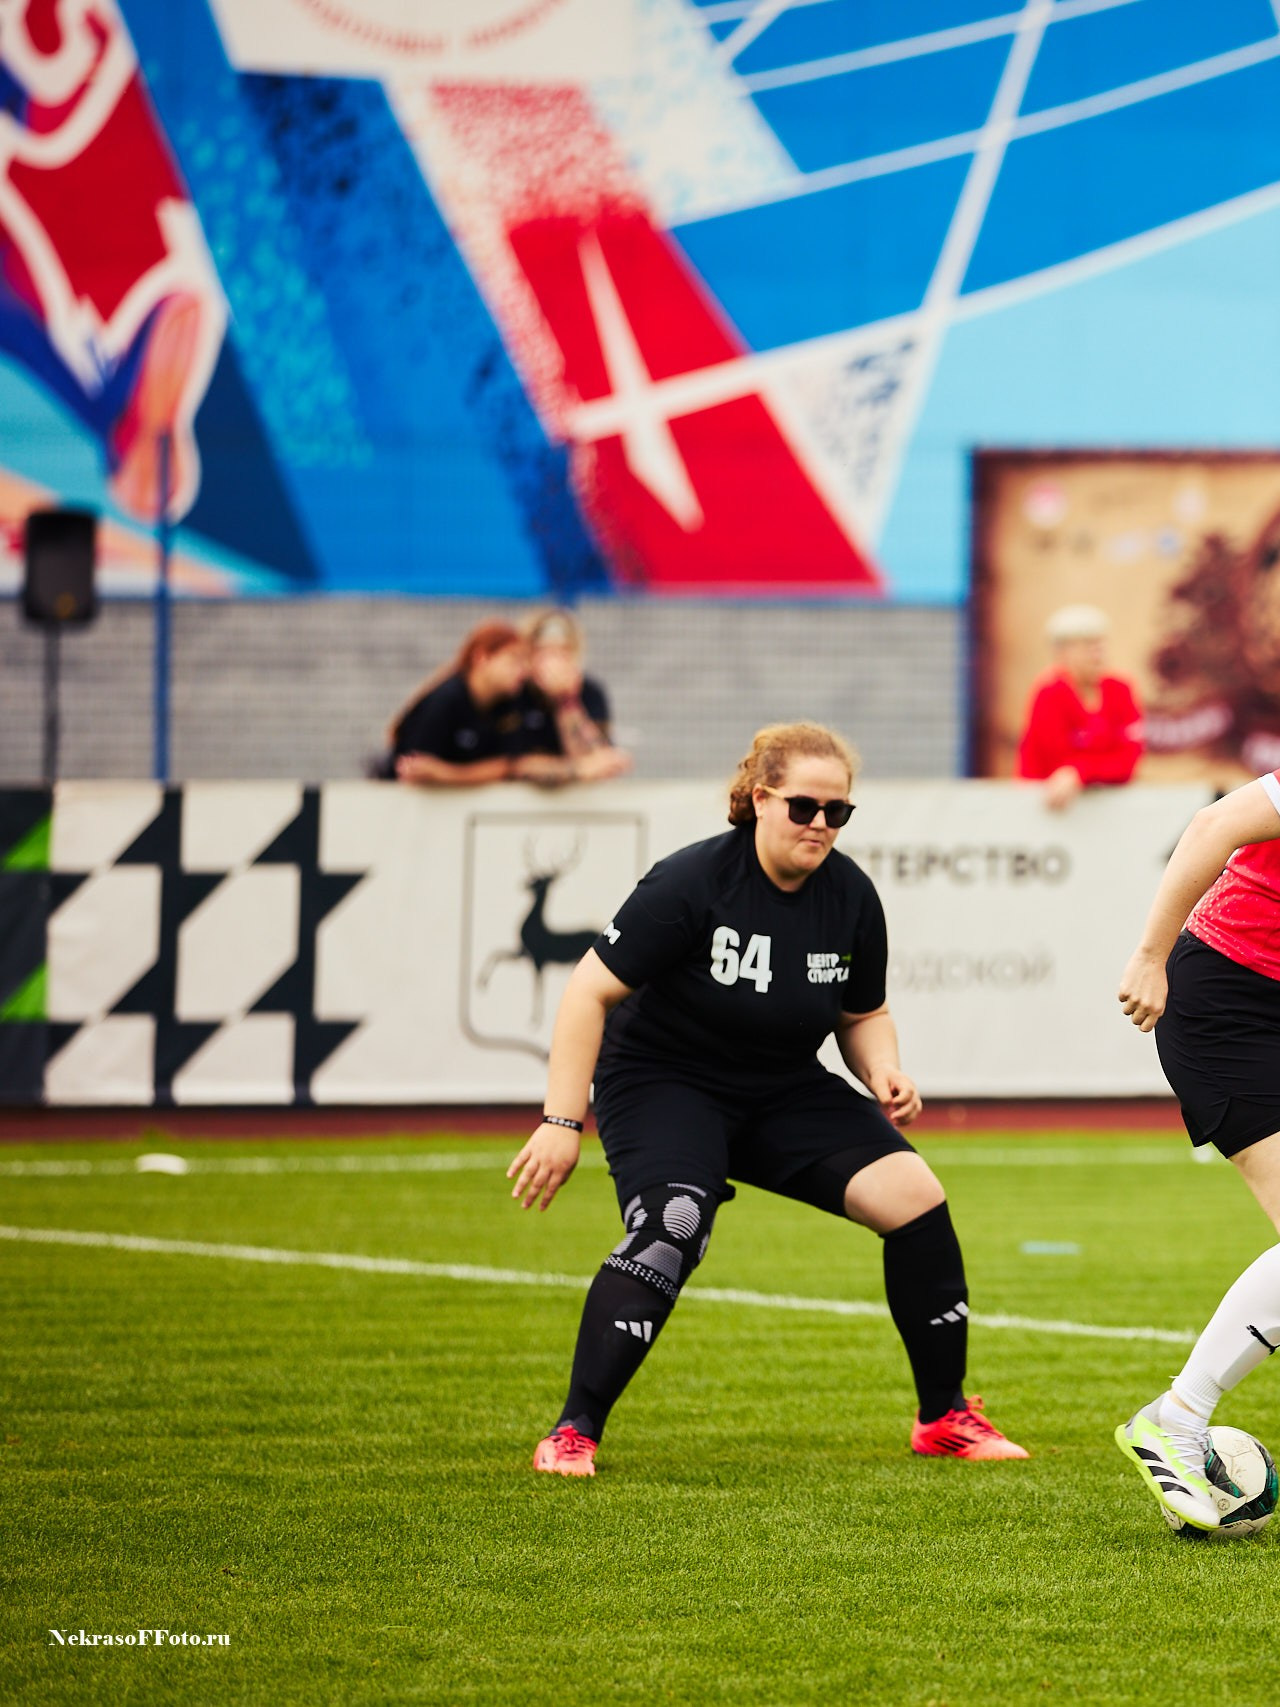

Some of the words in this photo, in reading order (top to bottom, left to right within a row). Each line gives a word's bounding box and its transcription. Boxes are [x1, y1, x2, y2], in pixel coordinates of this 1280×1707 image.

[854, 846, 1070, 883] ТЕРСТВО
[710, 925, 773, 994] 64
[886, 944, 1056, 990] ОДСКОЙ
